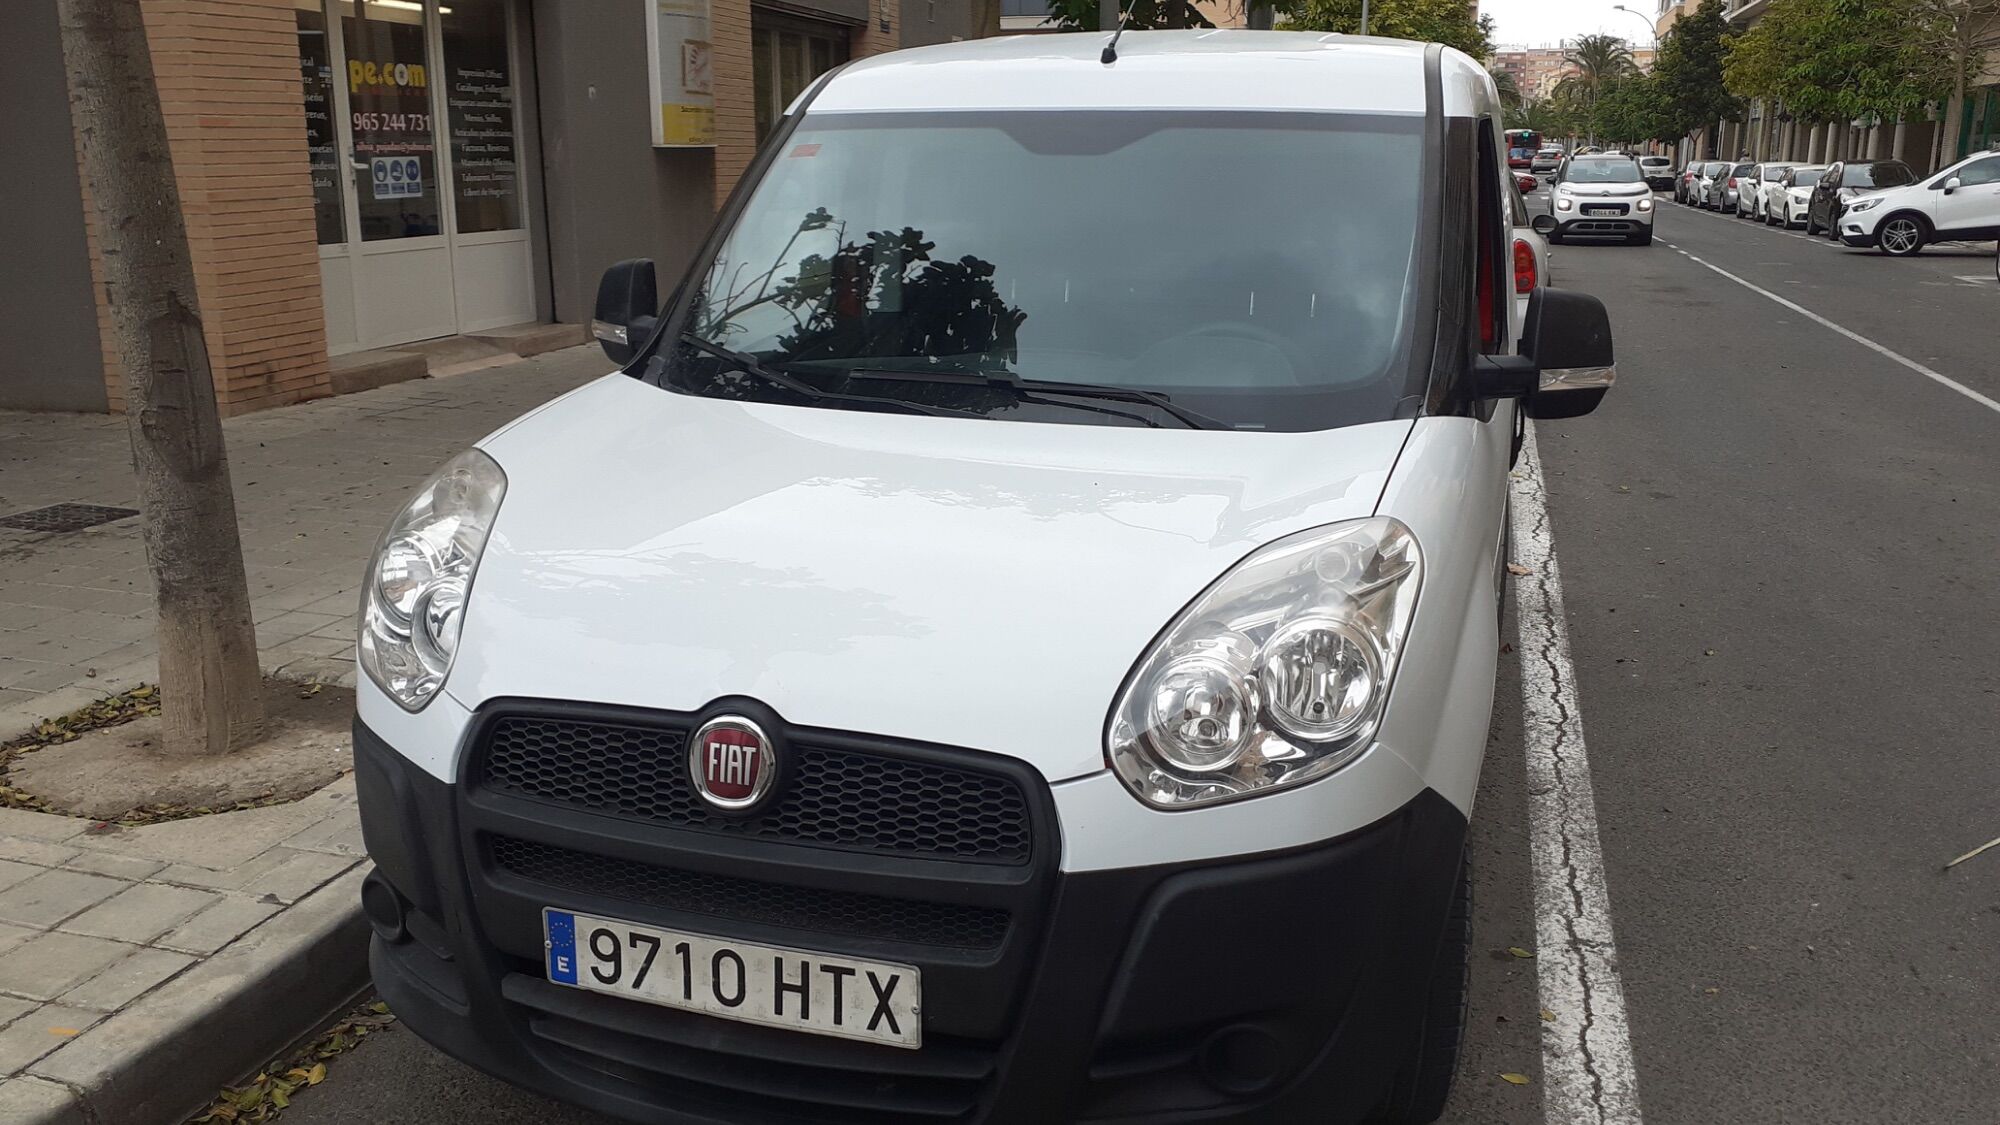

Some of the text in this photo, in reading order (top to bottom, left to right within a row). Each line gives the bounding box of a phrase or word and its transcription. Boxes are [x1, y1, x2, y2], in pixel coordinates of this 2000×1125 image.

[349, 59, 426, 93] pe.com
[353, 113, 431, 132] 965 244 731
[708, 742, 757, 786] FIAT
[557, 956, 570, 973] E
[590, 928, 902, 1035] 9710 HTX
